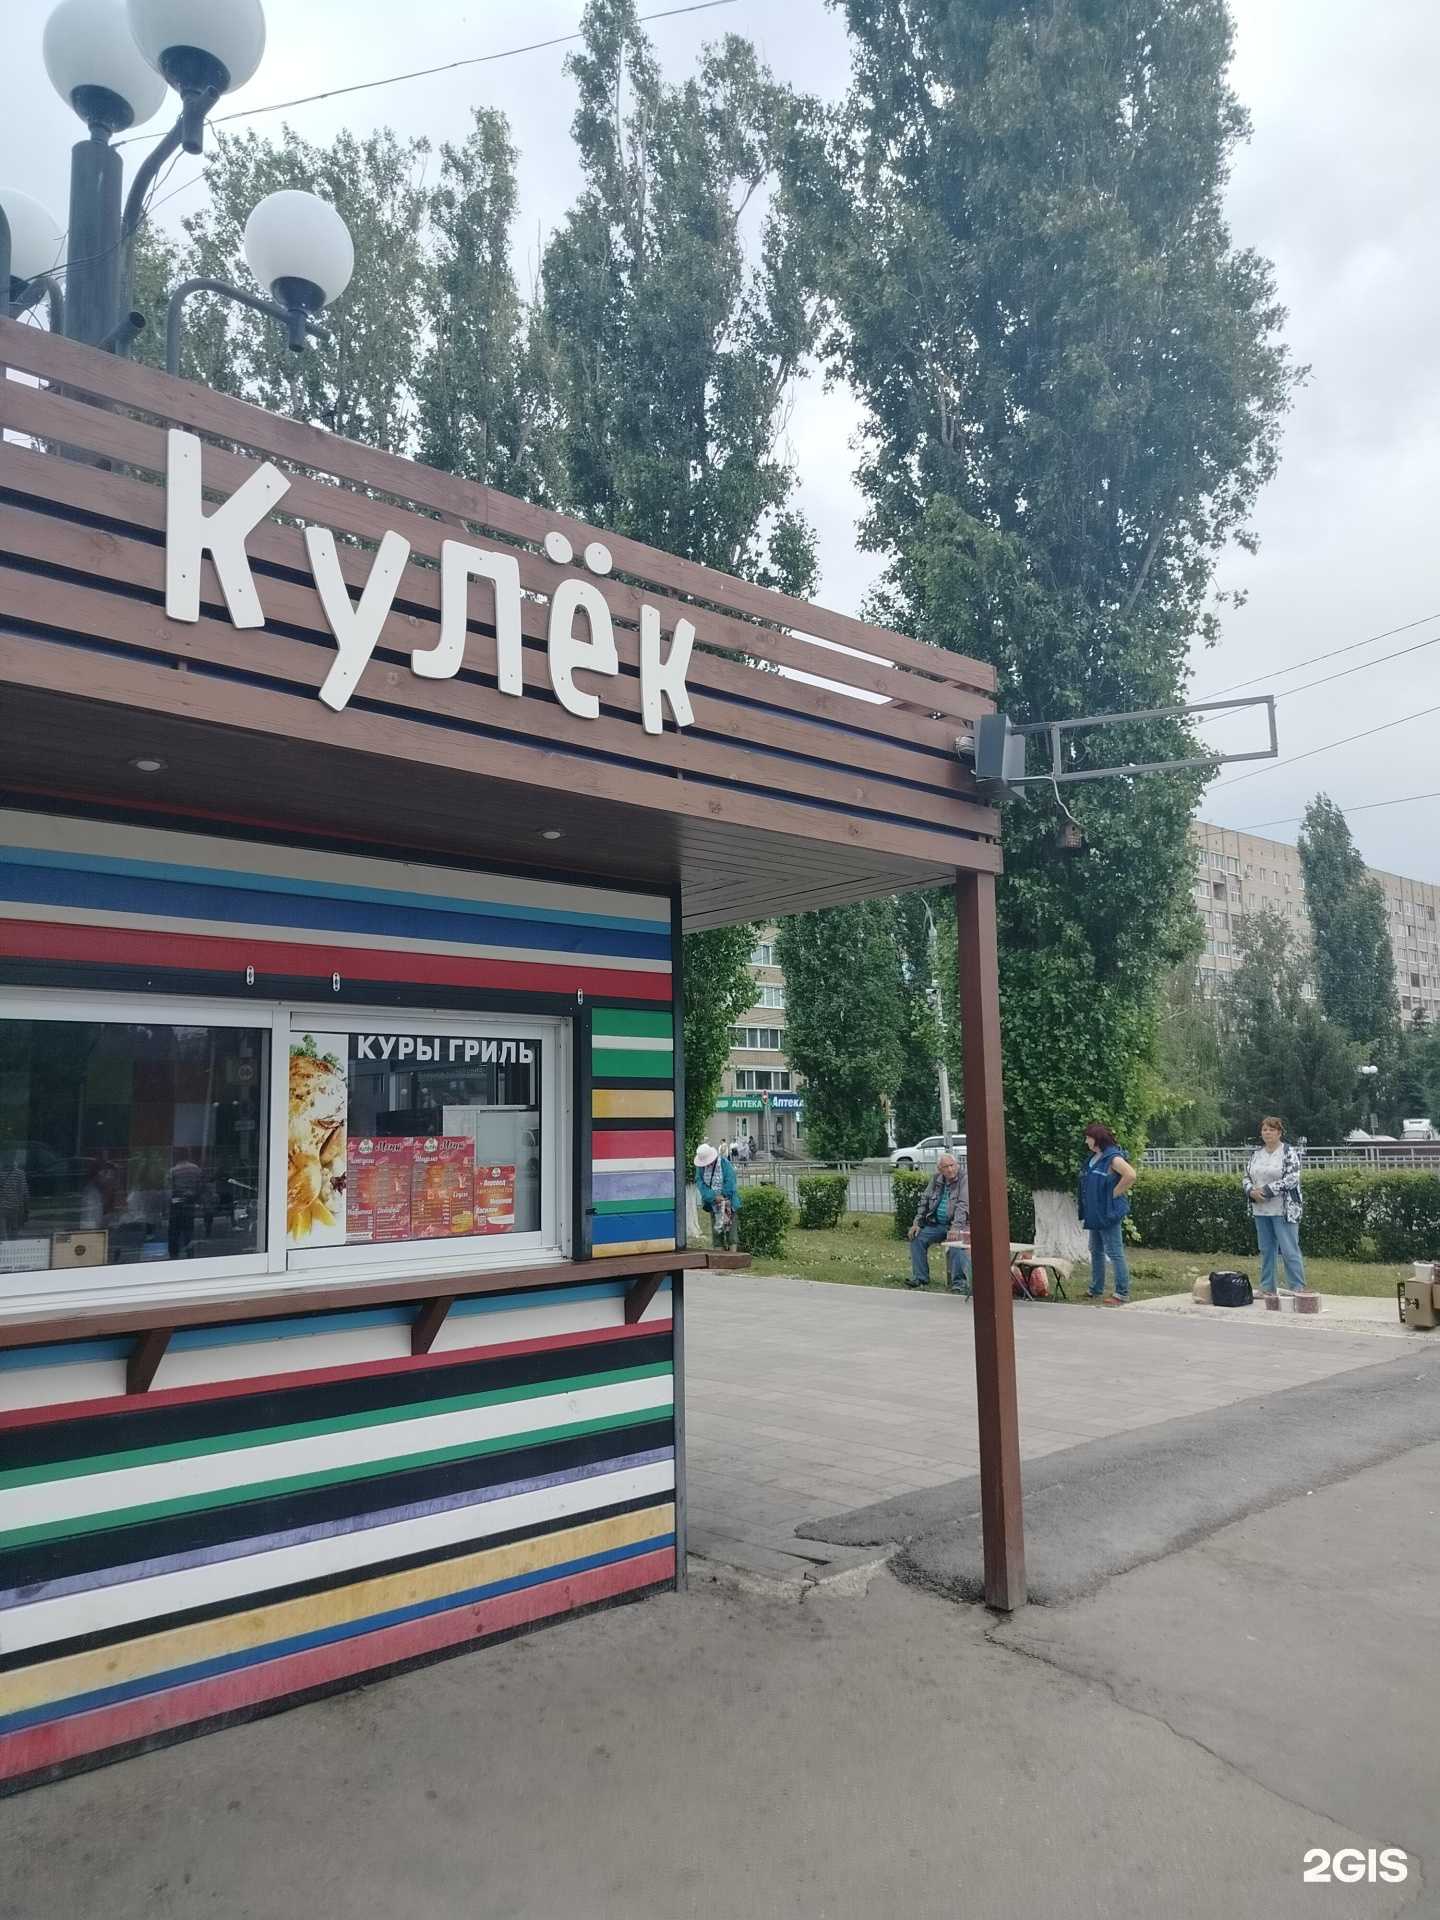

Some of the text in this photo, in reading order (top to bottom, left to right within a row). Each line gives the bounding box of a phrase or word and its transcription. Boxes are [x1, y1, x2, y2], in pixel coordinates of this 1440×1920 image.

[165, 428, 696, 735] Кулёк
[357, 1035, 534, 1065] КУРЫ ГРИЛЬ
[732, 1100, 762, 1108] АПТЕКА
